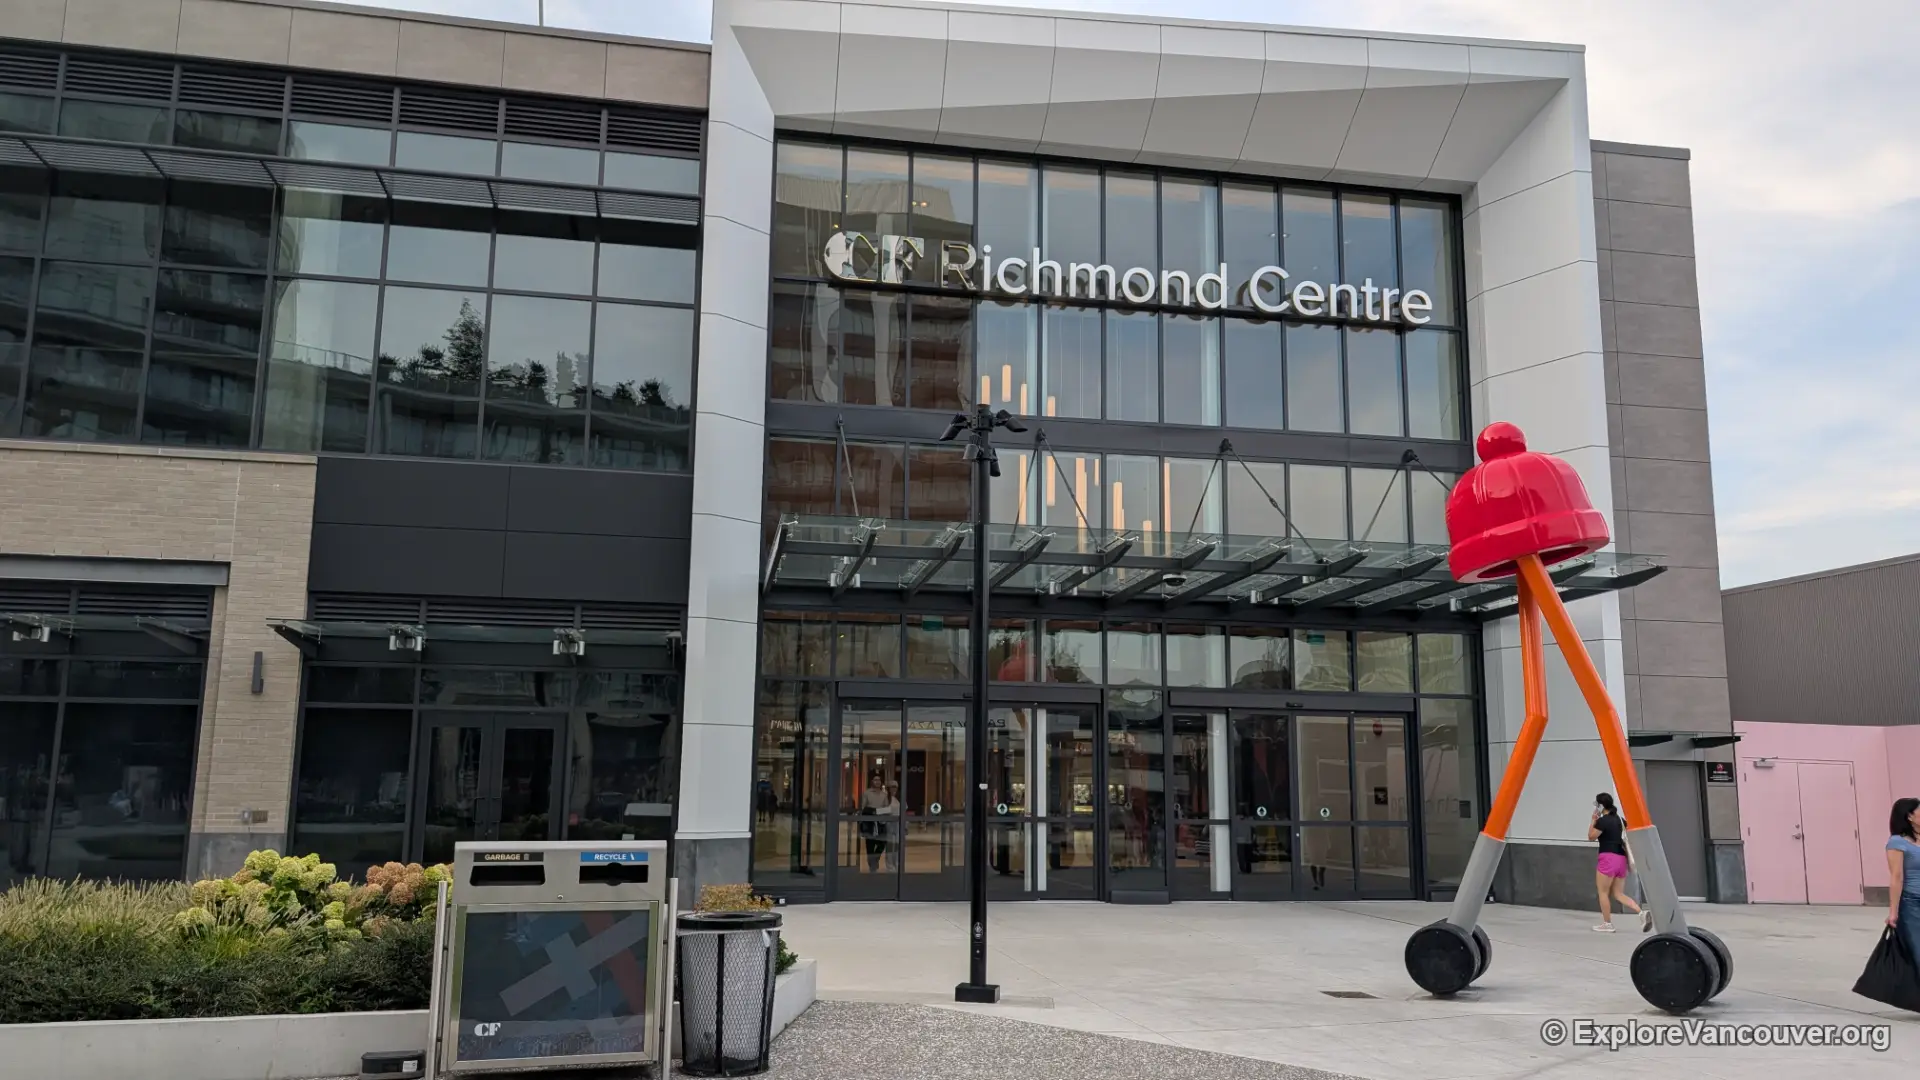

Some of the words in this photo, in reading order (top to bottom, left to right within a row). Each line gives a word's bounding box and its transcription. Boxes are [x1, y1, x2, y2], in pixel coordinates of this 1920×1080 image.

[823, 230, 925, 284] CF
[940, 240, 1228, 309] Richmond
[1249, 265, 1433, 325] Centre
[484, 853, 521, 861] GARBAGE
[594, 853, 627, 861] RECYCLE
[474, 1022, 501, 1037] CF
